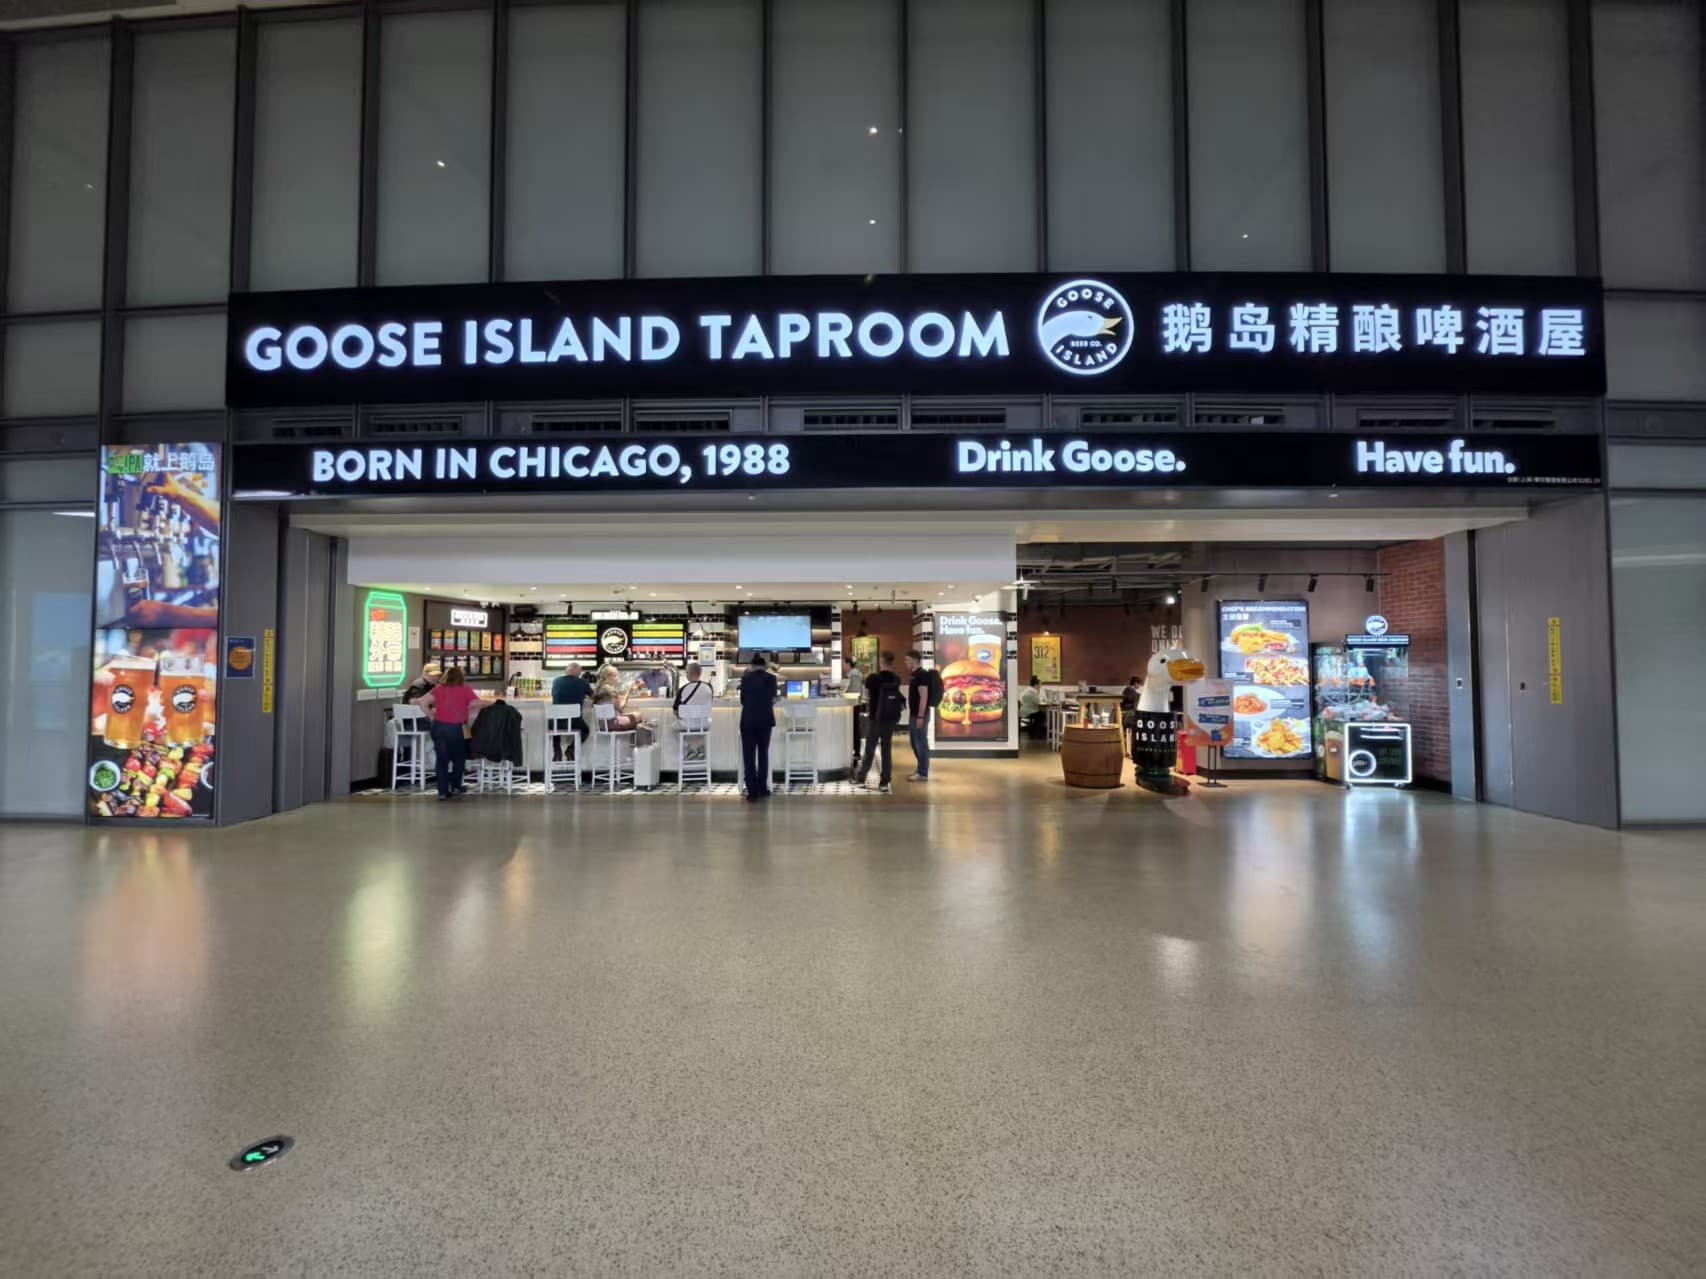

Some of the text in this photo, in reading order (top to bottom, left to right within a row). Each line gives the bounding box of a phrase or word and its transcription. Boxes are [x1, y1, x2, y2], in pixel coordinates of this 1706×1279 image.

[1056, 288, 1114, 309] GOOSE
[1161, 301, 1586, 356] 鹅岛精酿啤酒屋
[244, 310, 1010, 372] GOOSE ISLAND TAPROOM
[1055, 343, 1117, 365] ISLAND
[312, 442, 791, 484] BORN IN CHICAGO, 1988
[956, 437, 1187, 473] Drink Goose.
[1355, 438, 1516, 474] Have fun.
[940, 615, 967, 625] Drink
[940, 625, 964, 635] Have
[1150, 624, 1167, 639] WE
[1034, 645, 1049, 659] 312
